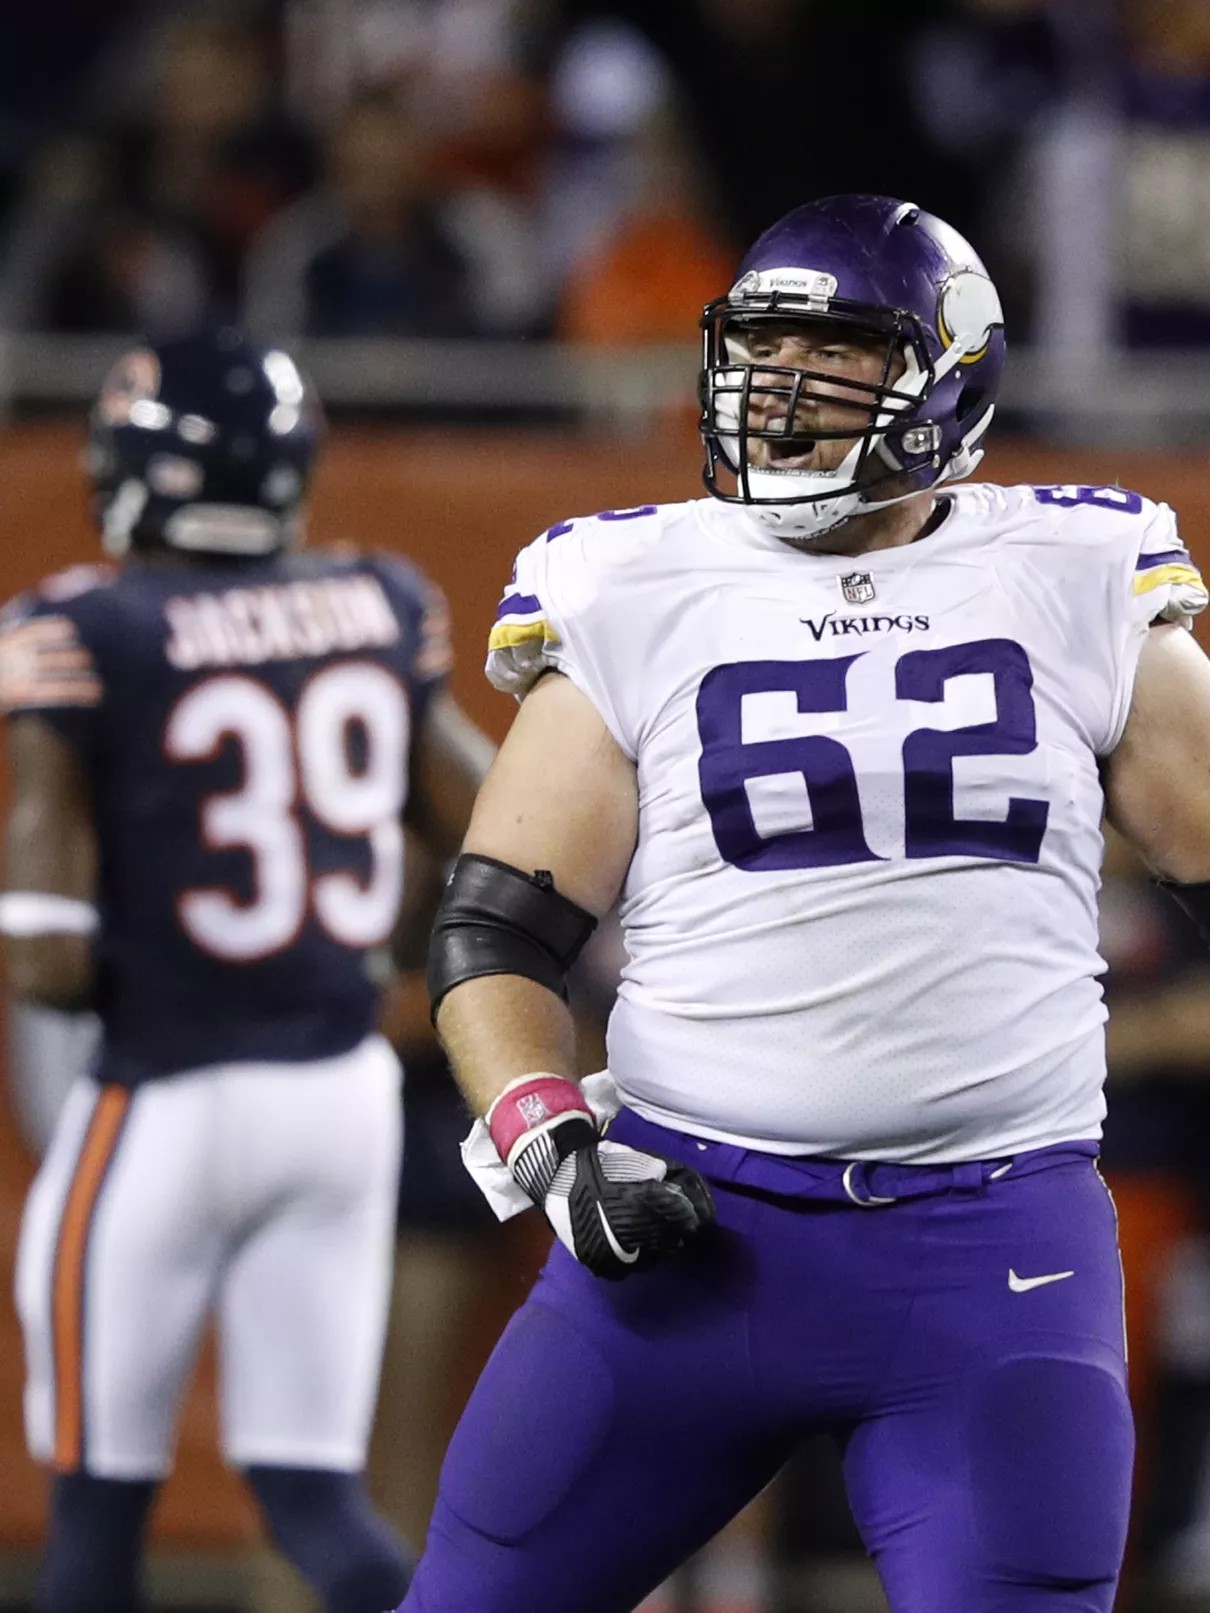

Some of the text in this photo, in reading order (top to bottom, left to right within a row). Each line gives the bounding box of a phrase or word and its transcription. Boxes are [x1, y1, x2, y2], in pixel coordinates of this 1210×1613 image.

[847, 585, 873, 600] NFL
[164, 658, 411, 962] 39
[696, 638, 1050, 872] 62
